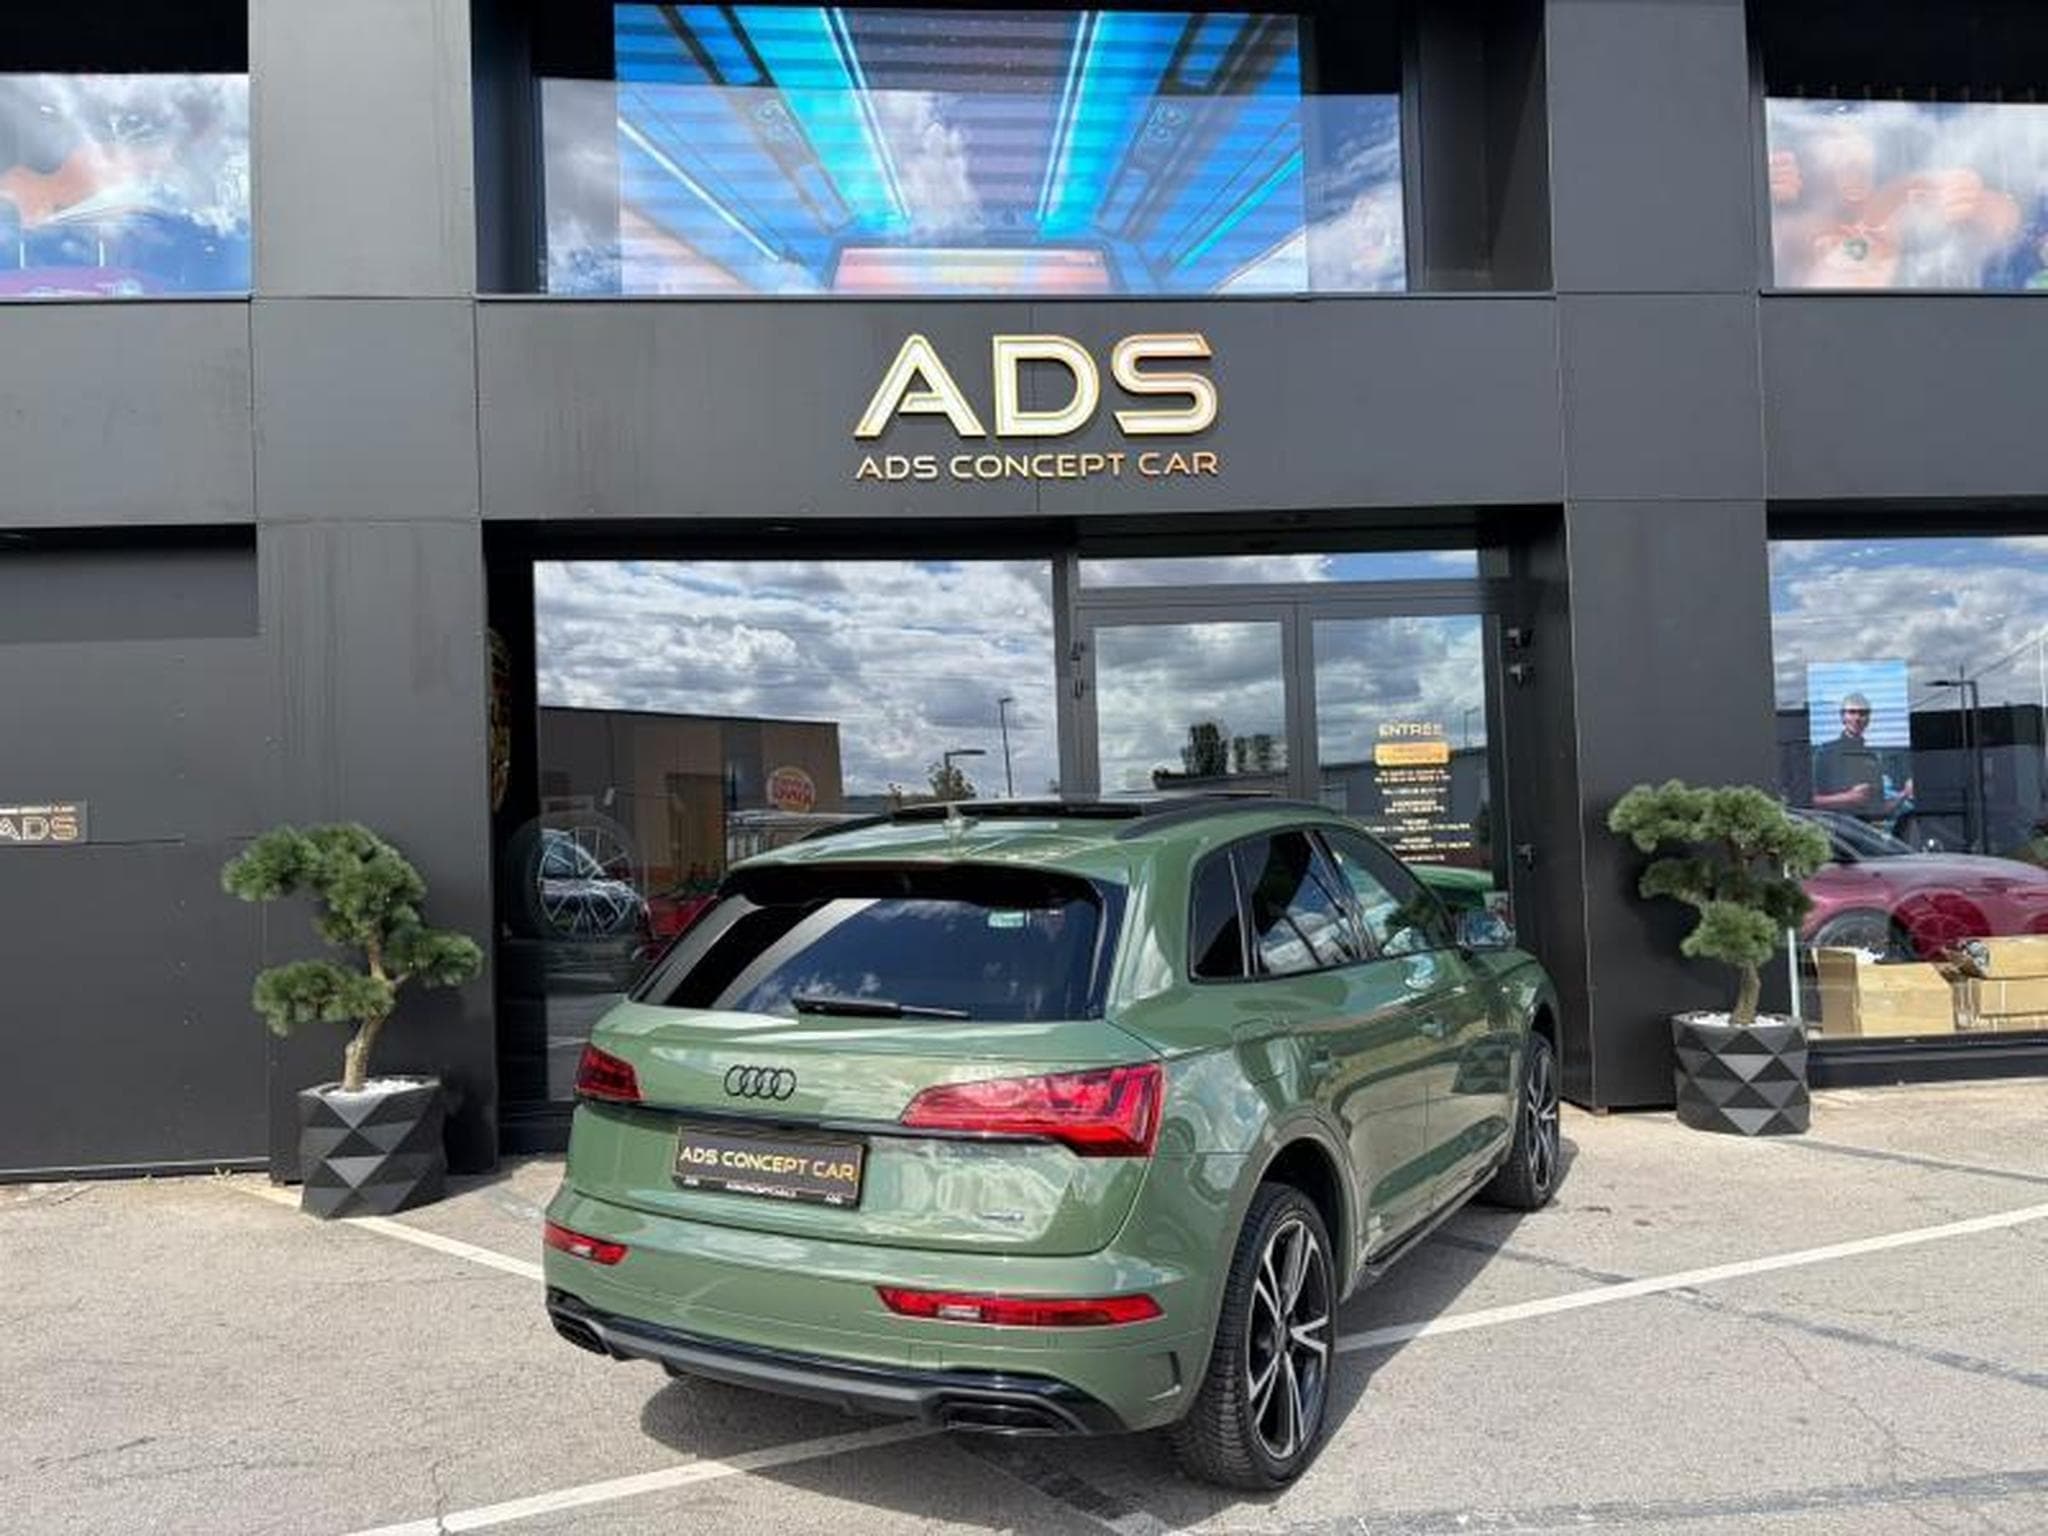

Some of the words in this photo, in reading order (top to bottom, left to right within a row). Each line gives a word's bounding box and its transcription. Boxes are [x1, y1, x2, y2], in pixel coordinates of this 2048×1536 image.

[853, 333, 1219, 437] ADS
[855, 455, 938, 480] ADS
[950, 453, 1125, 479] CONCEPT
[1138, 452, 1219, 477] CAR
[680, 1146, 718, 1166] ADS
[721, 1151, 809, 1176] CONCEPT
[812, 1161, 856, 1181] CAR
